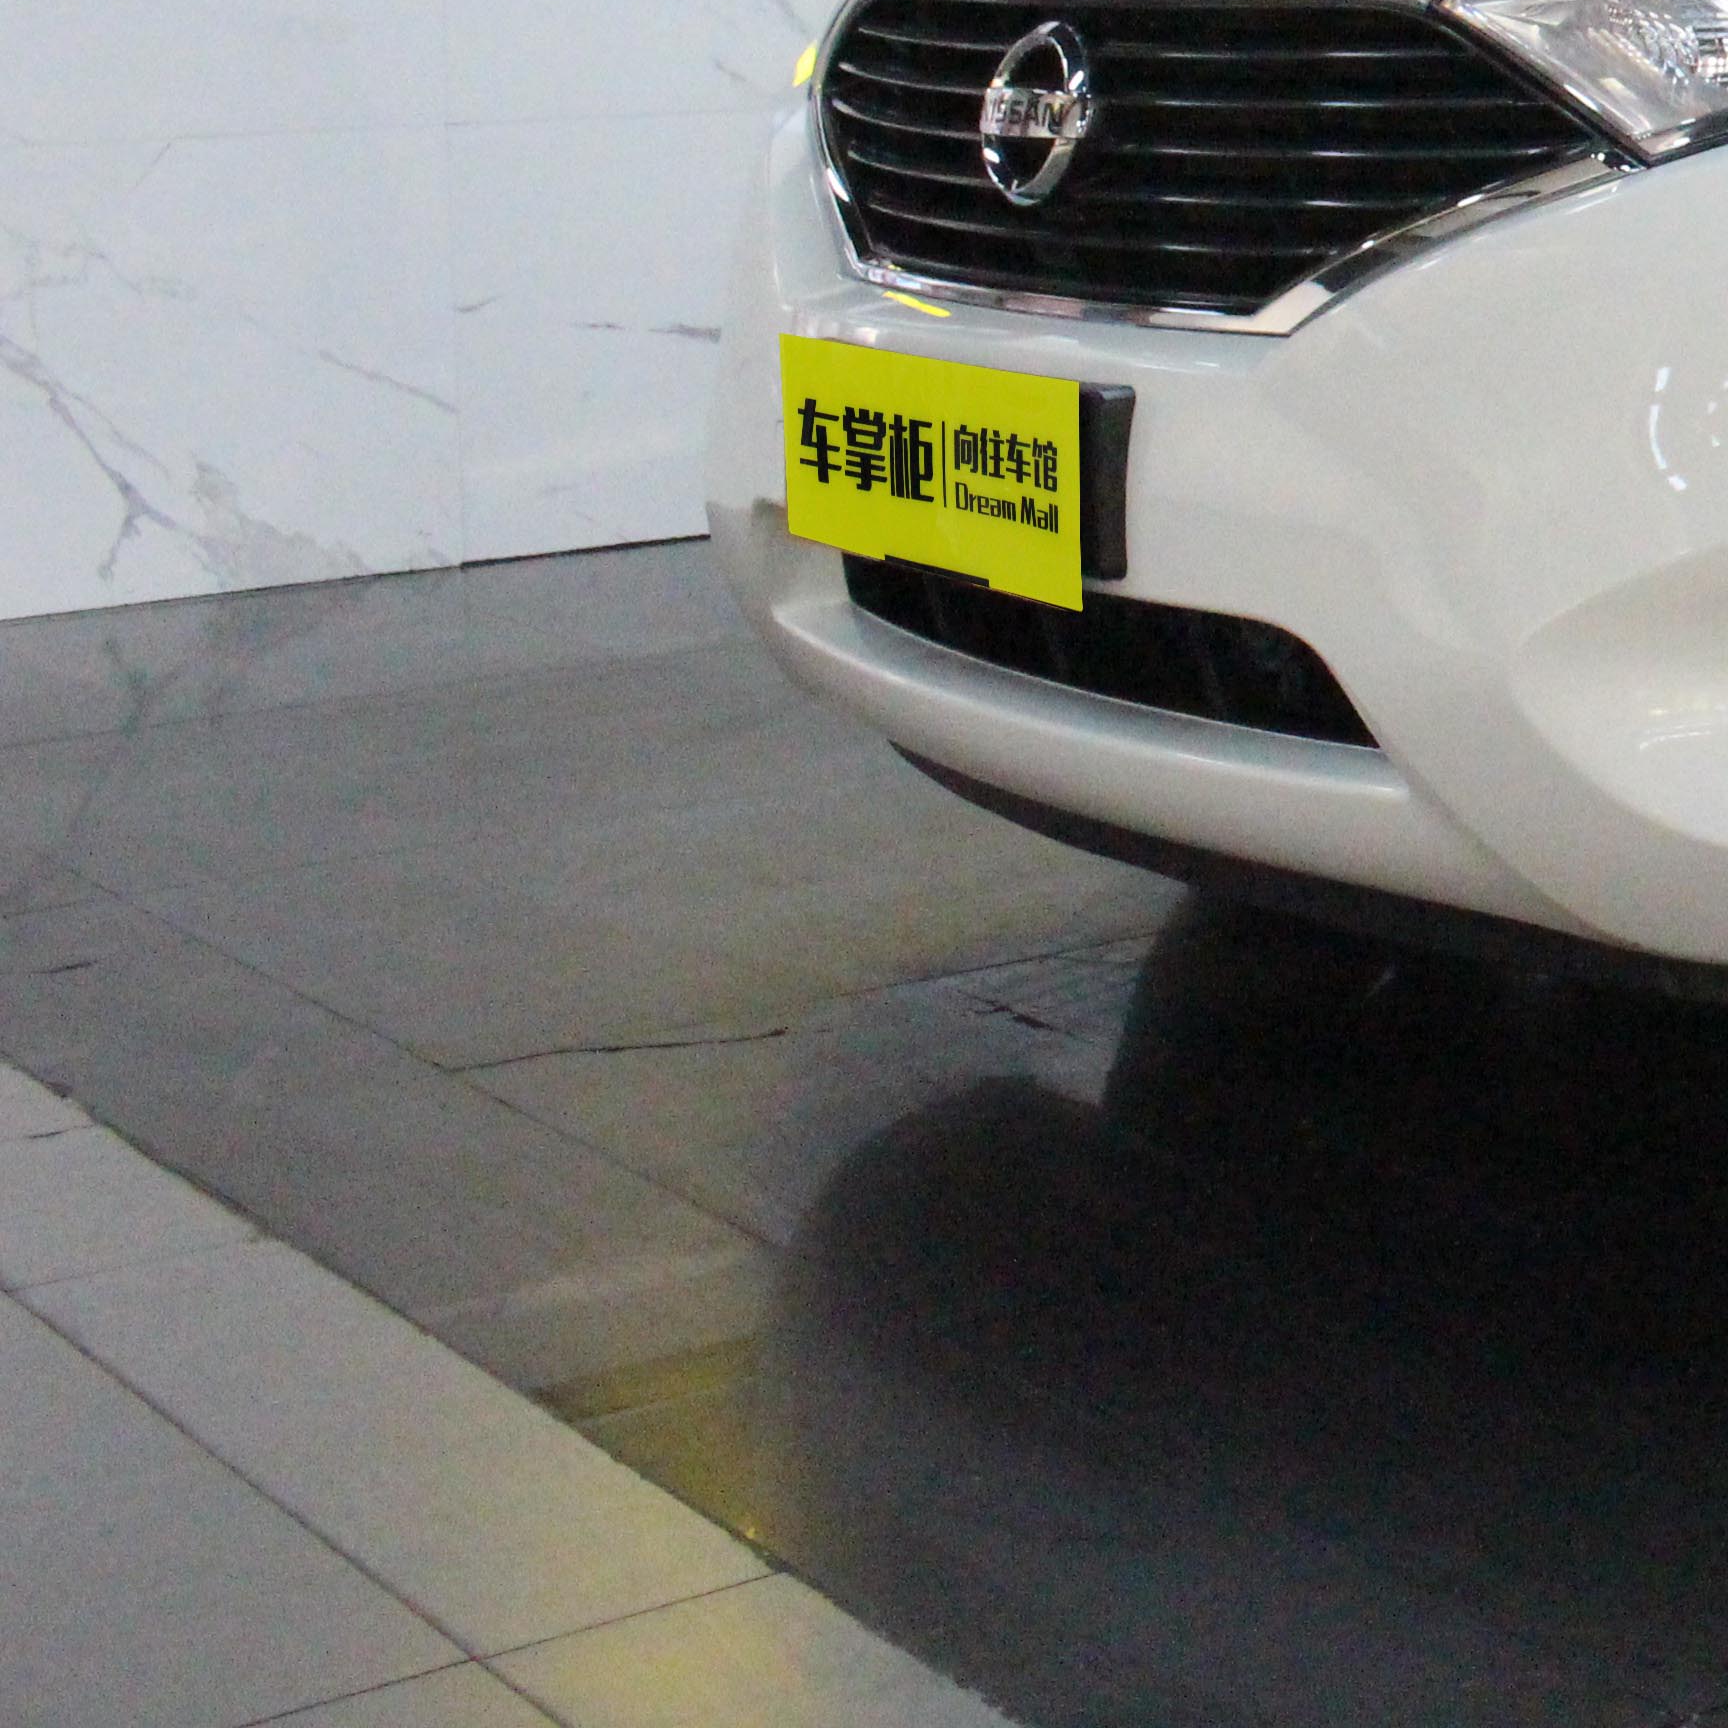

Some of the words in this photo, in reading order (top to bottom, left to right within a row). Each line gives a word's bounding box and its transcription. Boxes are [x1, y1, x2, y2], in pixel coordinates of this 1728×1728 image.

[797, 398, 934, 502] 车掌柜
[954, 424, 1058, 492] 向往车馆
[955, 482, 1016, 522] Dream
[1020, 496, 1059, 534] Mall
